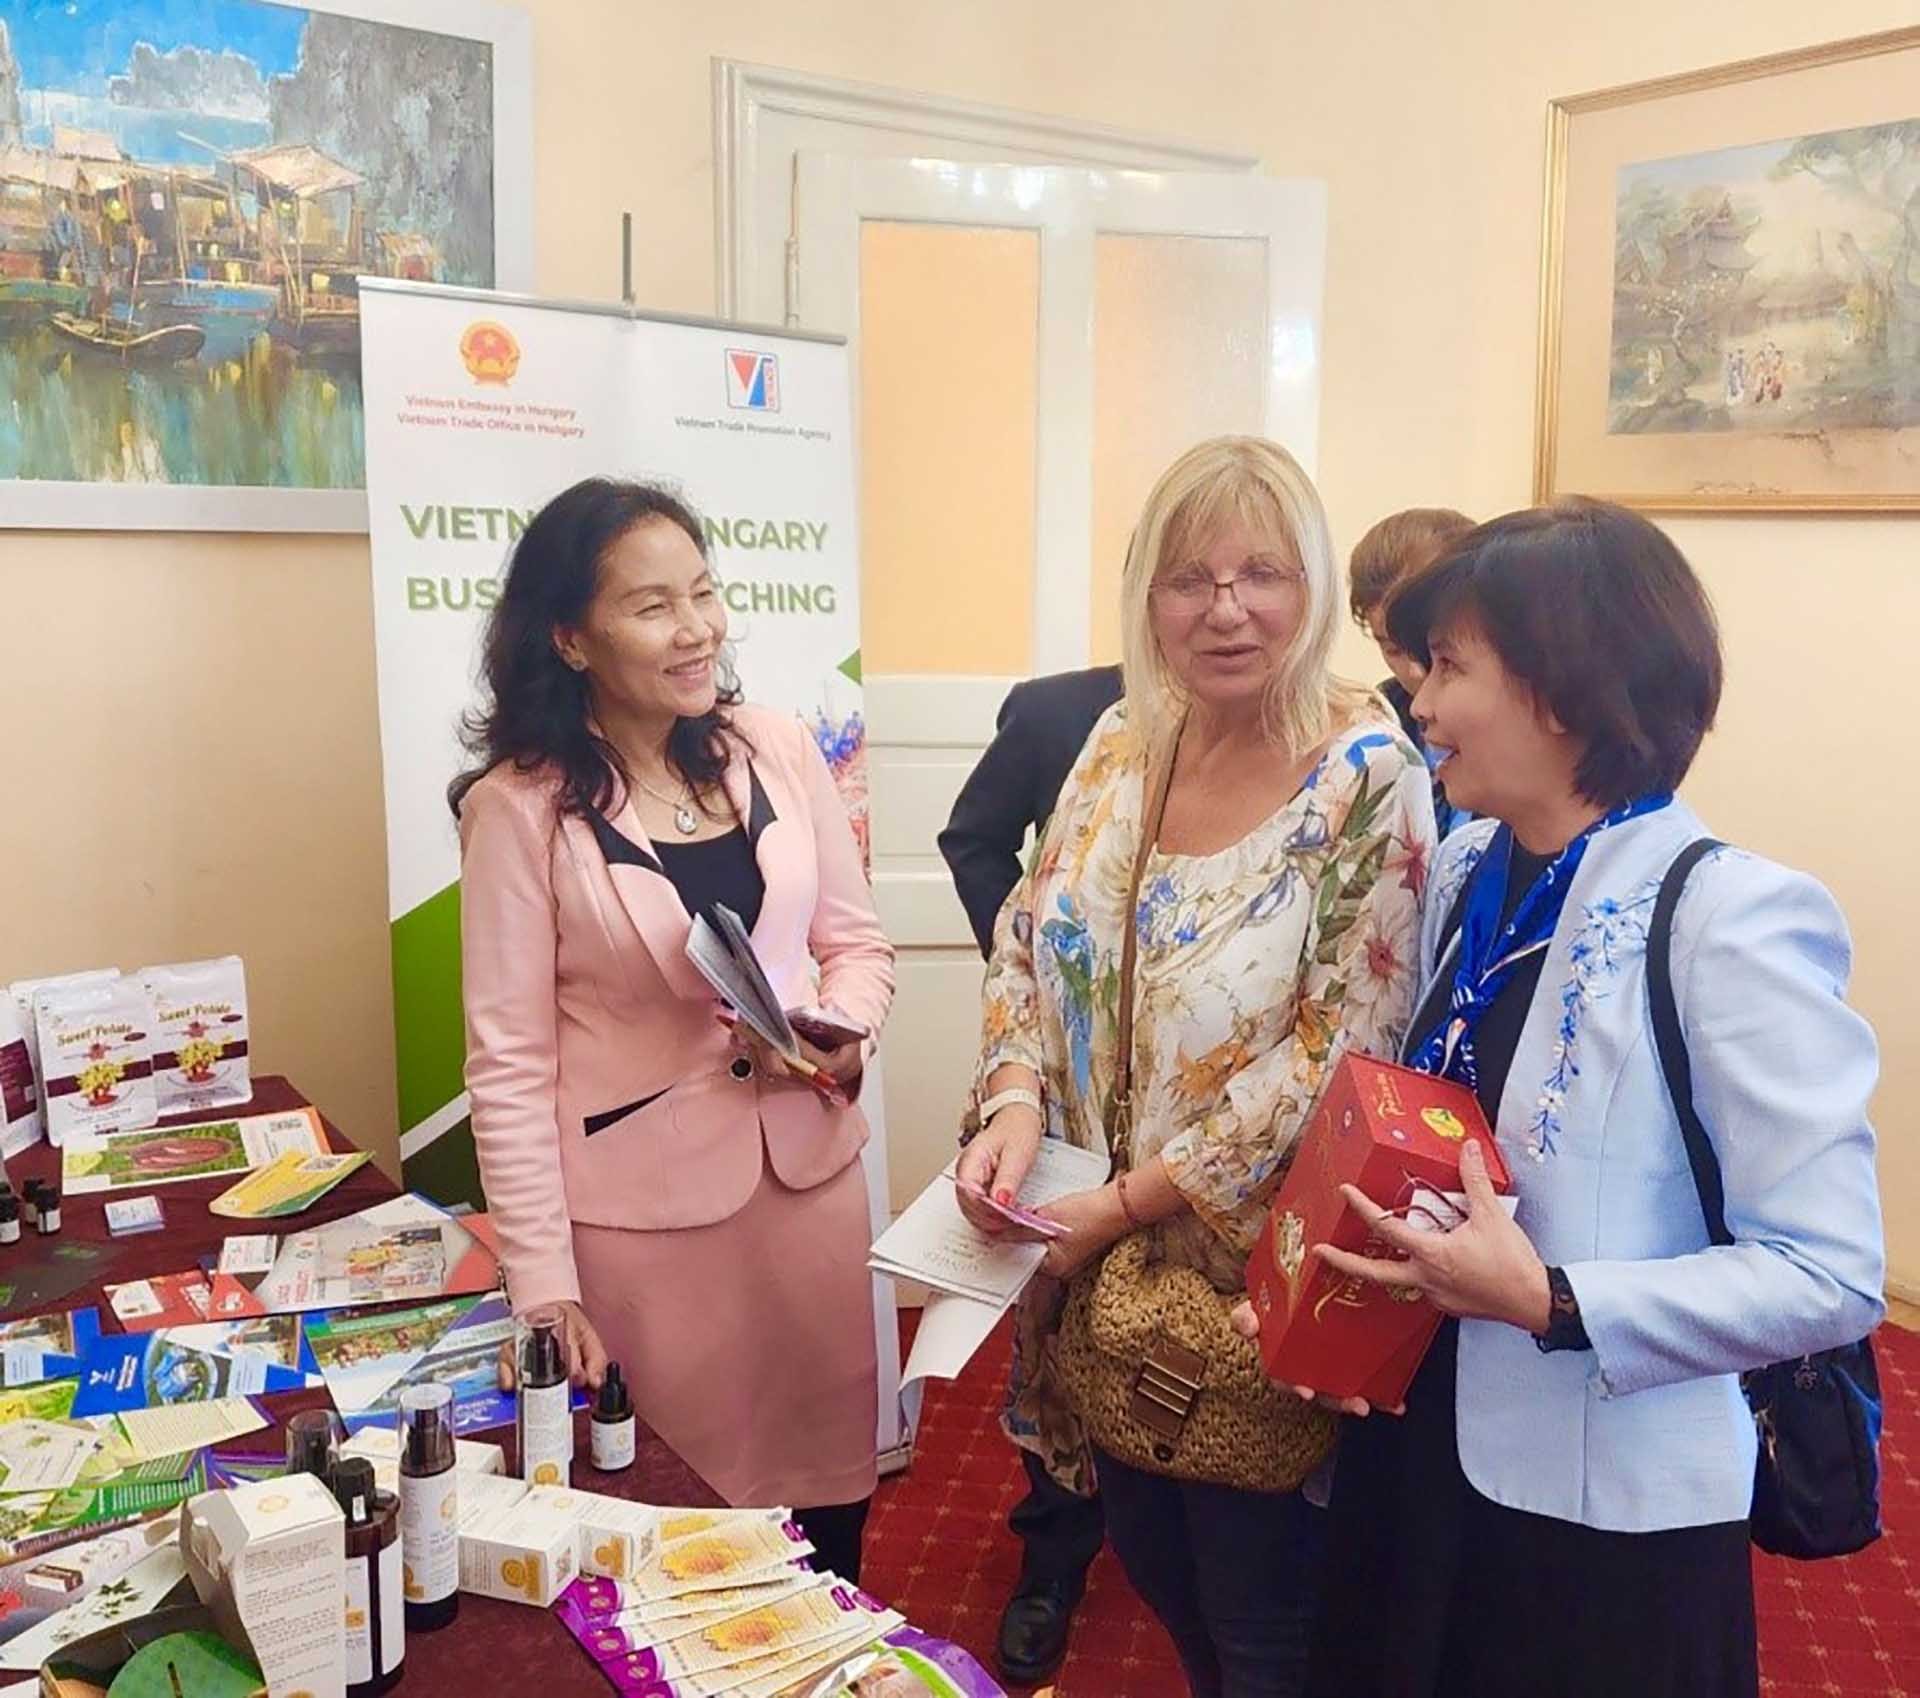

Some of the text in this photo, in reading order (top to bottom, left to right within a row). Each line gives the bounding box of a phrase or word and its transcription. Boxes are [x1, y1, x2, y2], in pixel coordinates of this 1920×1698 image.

[406, 395, 454, 410] Vietnam
[458, 399, 511, 416] Embassy
[528, 405, 576, 420] Hungary
[397, 413, 447, 426] Vietnam
[451, 415, 484, 429] Trade
[487, 418, 521, 432] Office
[538, 424, 584, 438] Hungary
[675, 416, 831, 441] Vietnam Trade Promotion Agency
[400, 504, 828, 551] VIETN NGARY
[724, 581, 836, 614] CHING
